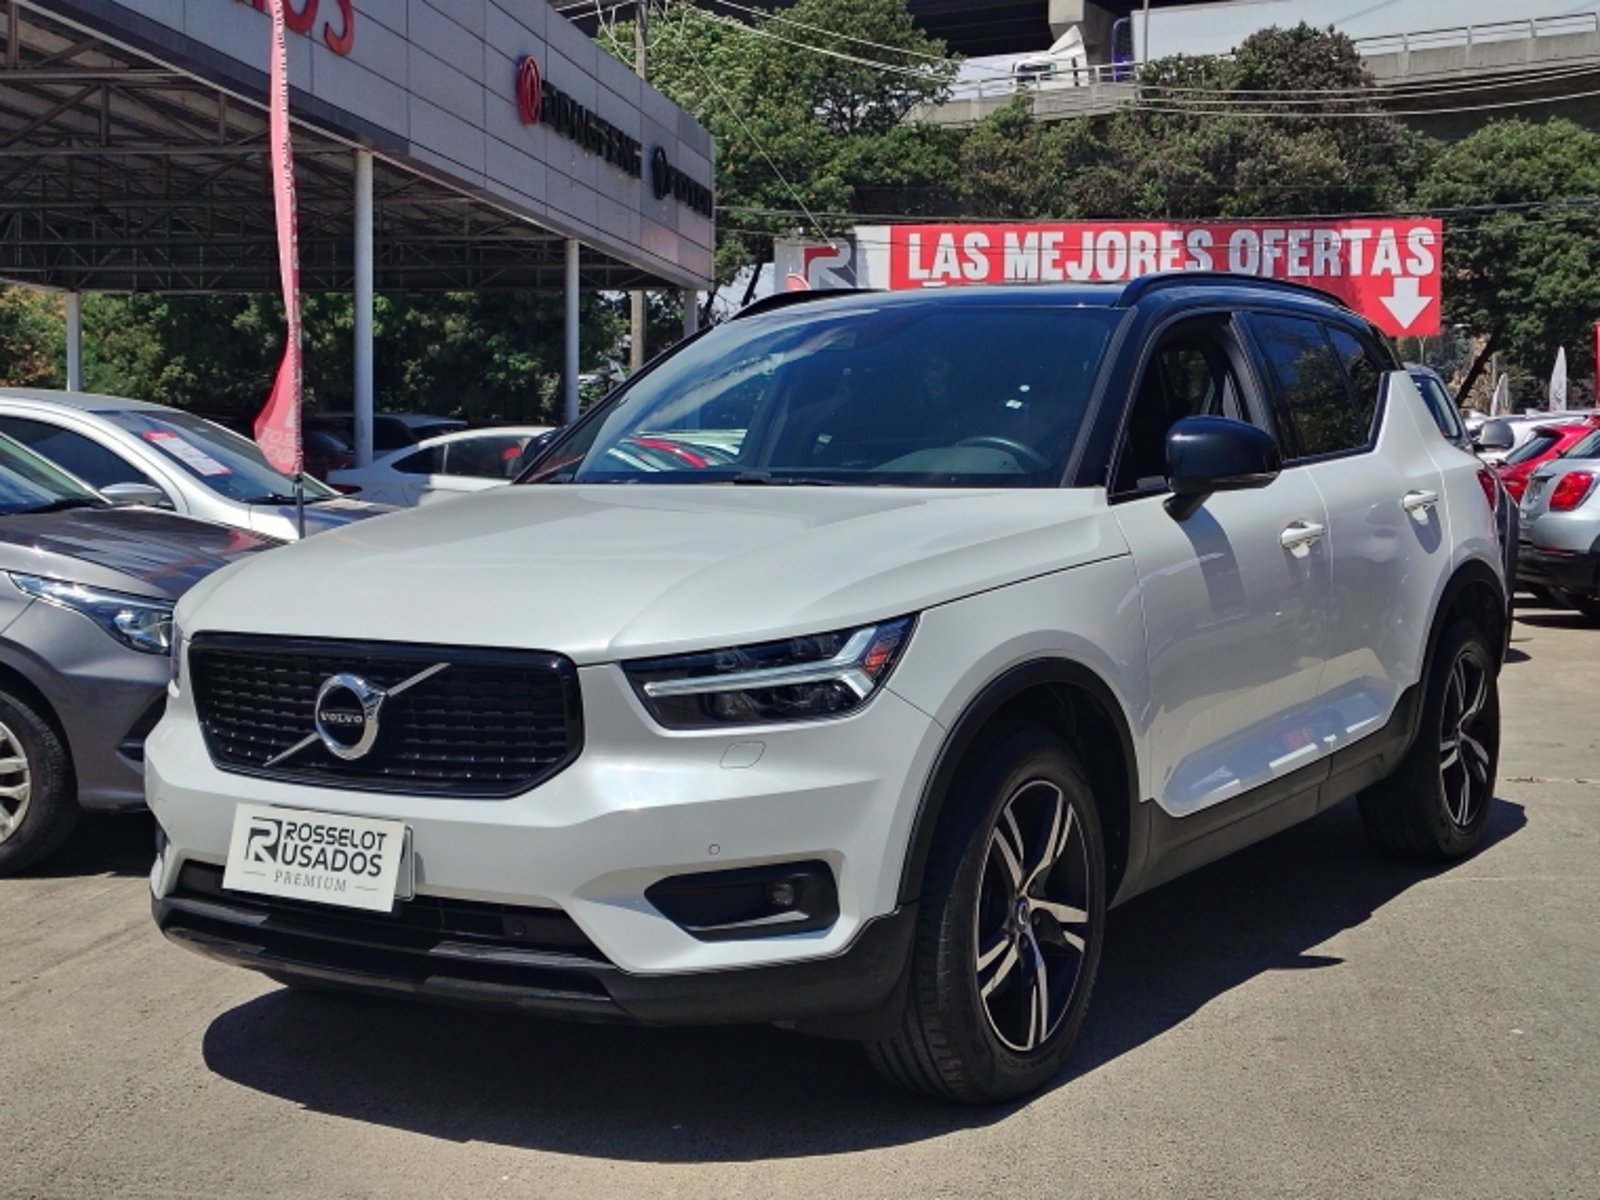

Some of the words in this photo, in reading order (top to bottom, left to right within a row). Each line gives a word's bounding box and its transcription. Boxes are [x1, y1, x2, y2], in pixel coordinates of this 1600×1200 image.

[908, 231, 991, 281] LAS
[1003, 229, 1214, 282] MEJORES
[1228, 226, 1436, 278] OFERTAS
[320, 712, 364, 724] VOLVO
[282, 821, 388, 852] ROSSELOT
[280, 842, 384, 878] USADOS
[273, 869, 348, 893] PREMIUM
